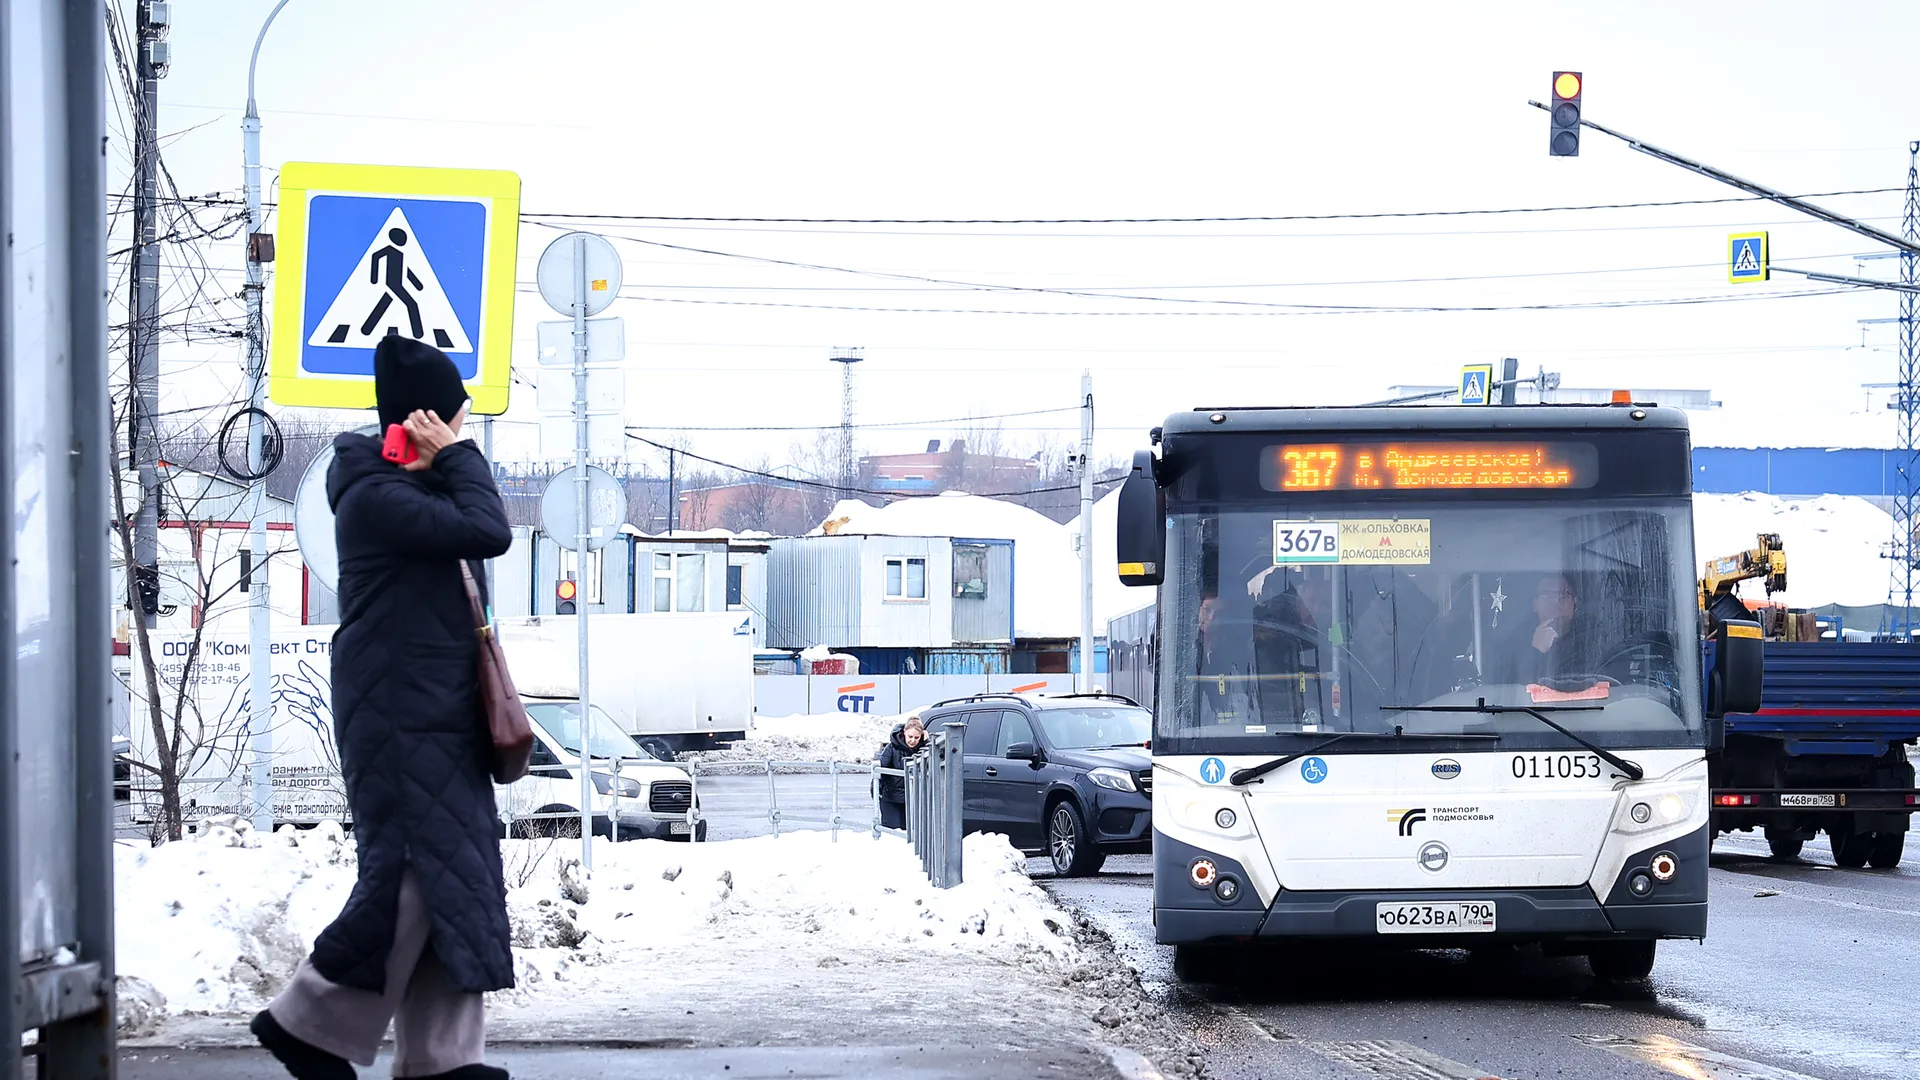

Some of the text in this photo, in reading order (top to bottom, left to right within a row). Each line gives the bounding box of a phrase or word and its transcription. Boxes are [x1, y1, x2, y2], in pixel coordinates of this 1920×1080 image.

[1284, 450, 1338, 487] 367
[1395, 468, 1569, 486] Домодедовская
[1342, 523, 1429, 534] ЖК «ОЛЬХОВКА»
[1342, 549, 1430, 560] ДОМОДЕДОВСКАЯ
[837, 694, 875, 713] СТГ
[1435, 764, 1459, 773] RUS
[1512, 755, 1601, 778] 011053
[289, 779, 330, 789] дорого
[1432, 806, 1480, 814] ТРАНСПОРТ
[1432, 814, 1494, 822] ПОДМОСКОВЬЯ
[1461, 904, 1490, 919] 790
